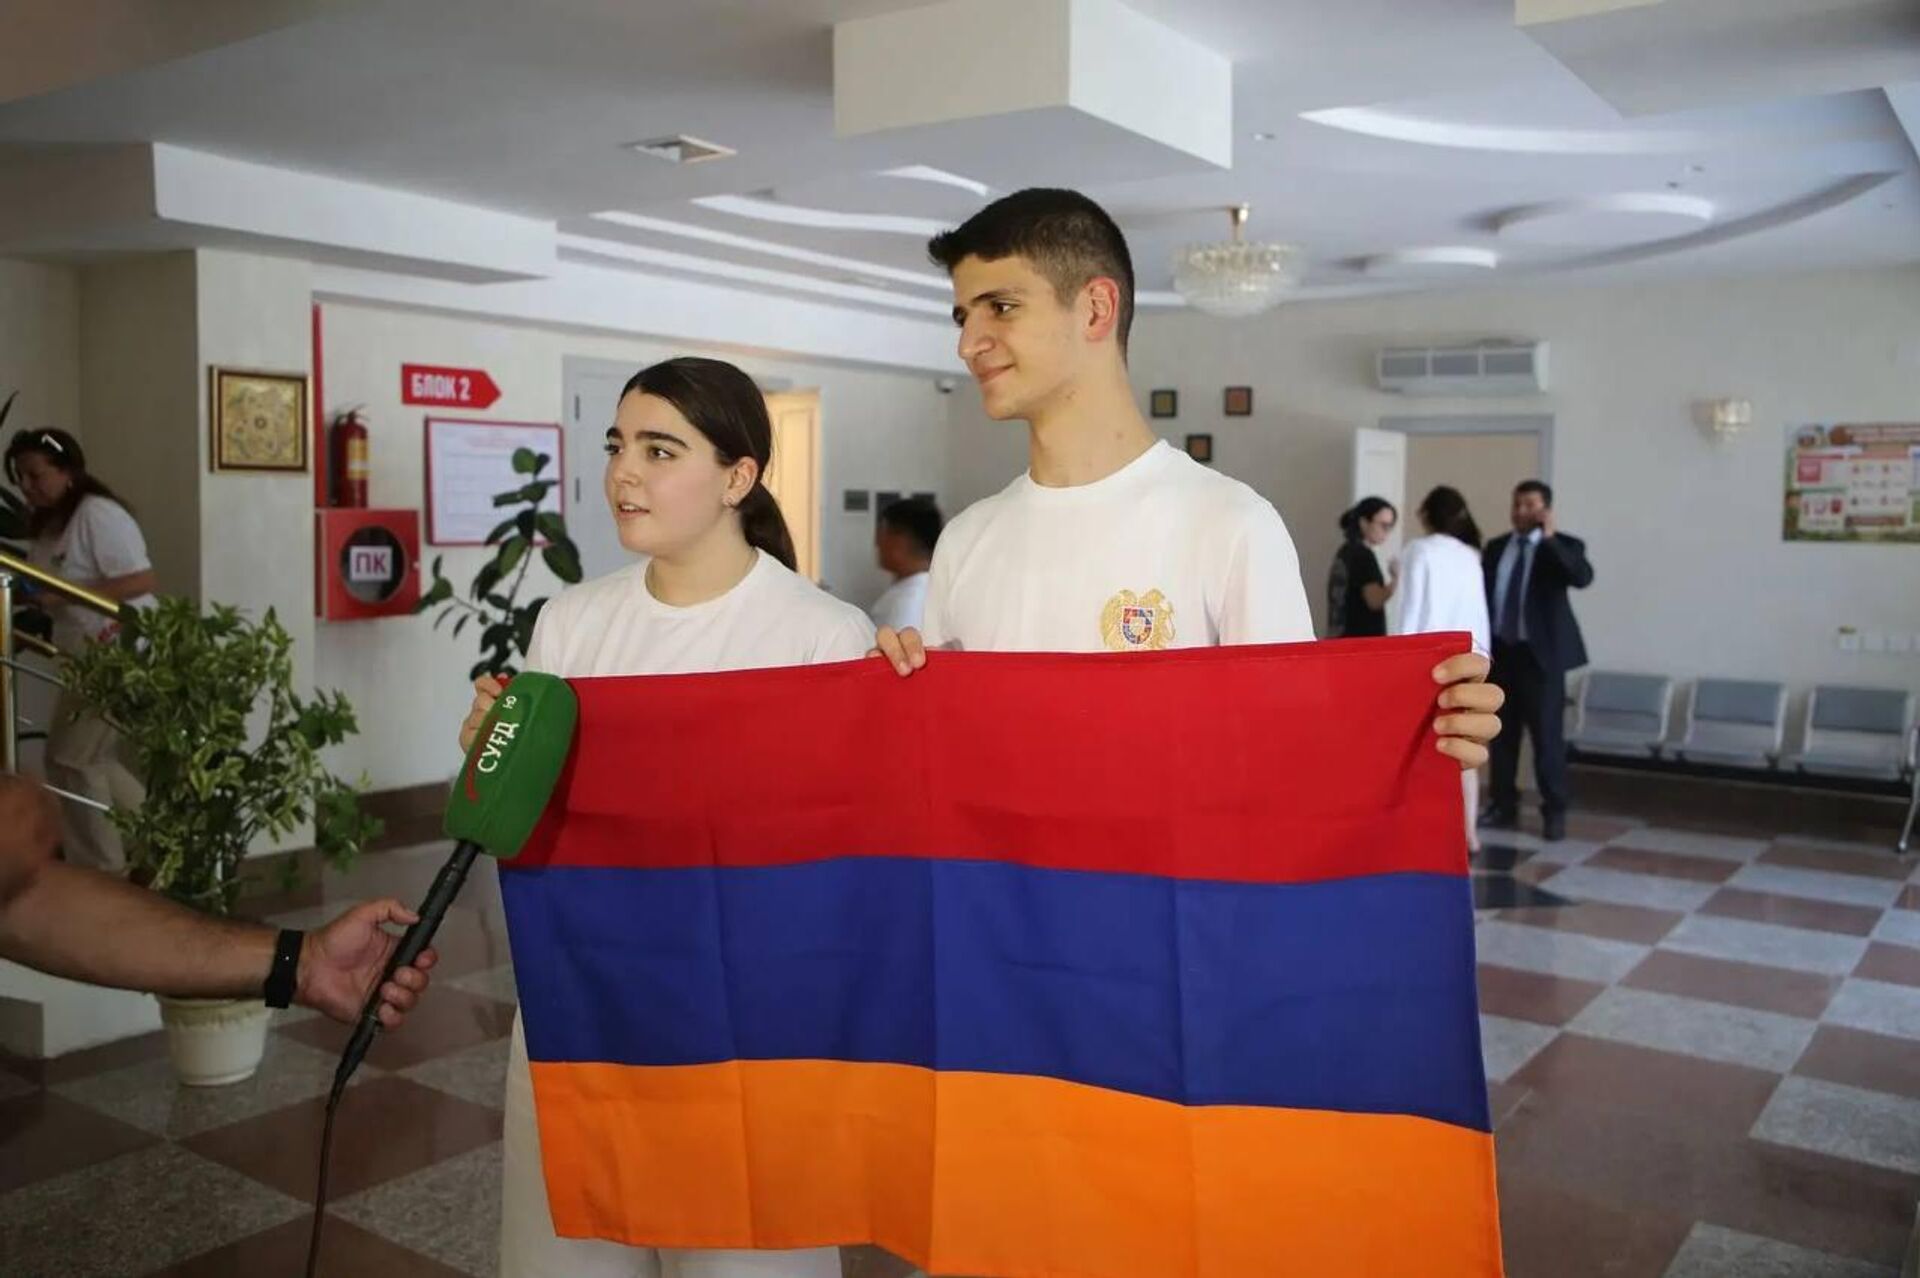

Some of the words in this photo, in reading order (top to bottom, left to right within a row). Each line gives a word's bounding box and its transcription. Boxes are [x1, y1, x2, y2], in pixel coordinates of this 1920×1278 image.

[411, 373, 455, 399] БЛОК
[459, 376, 470, 400] 2
[356, 552, 385, 571] ПК
